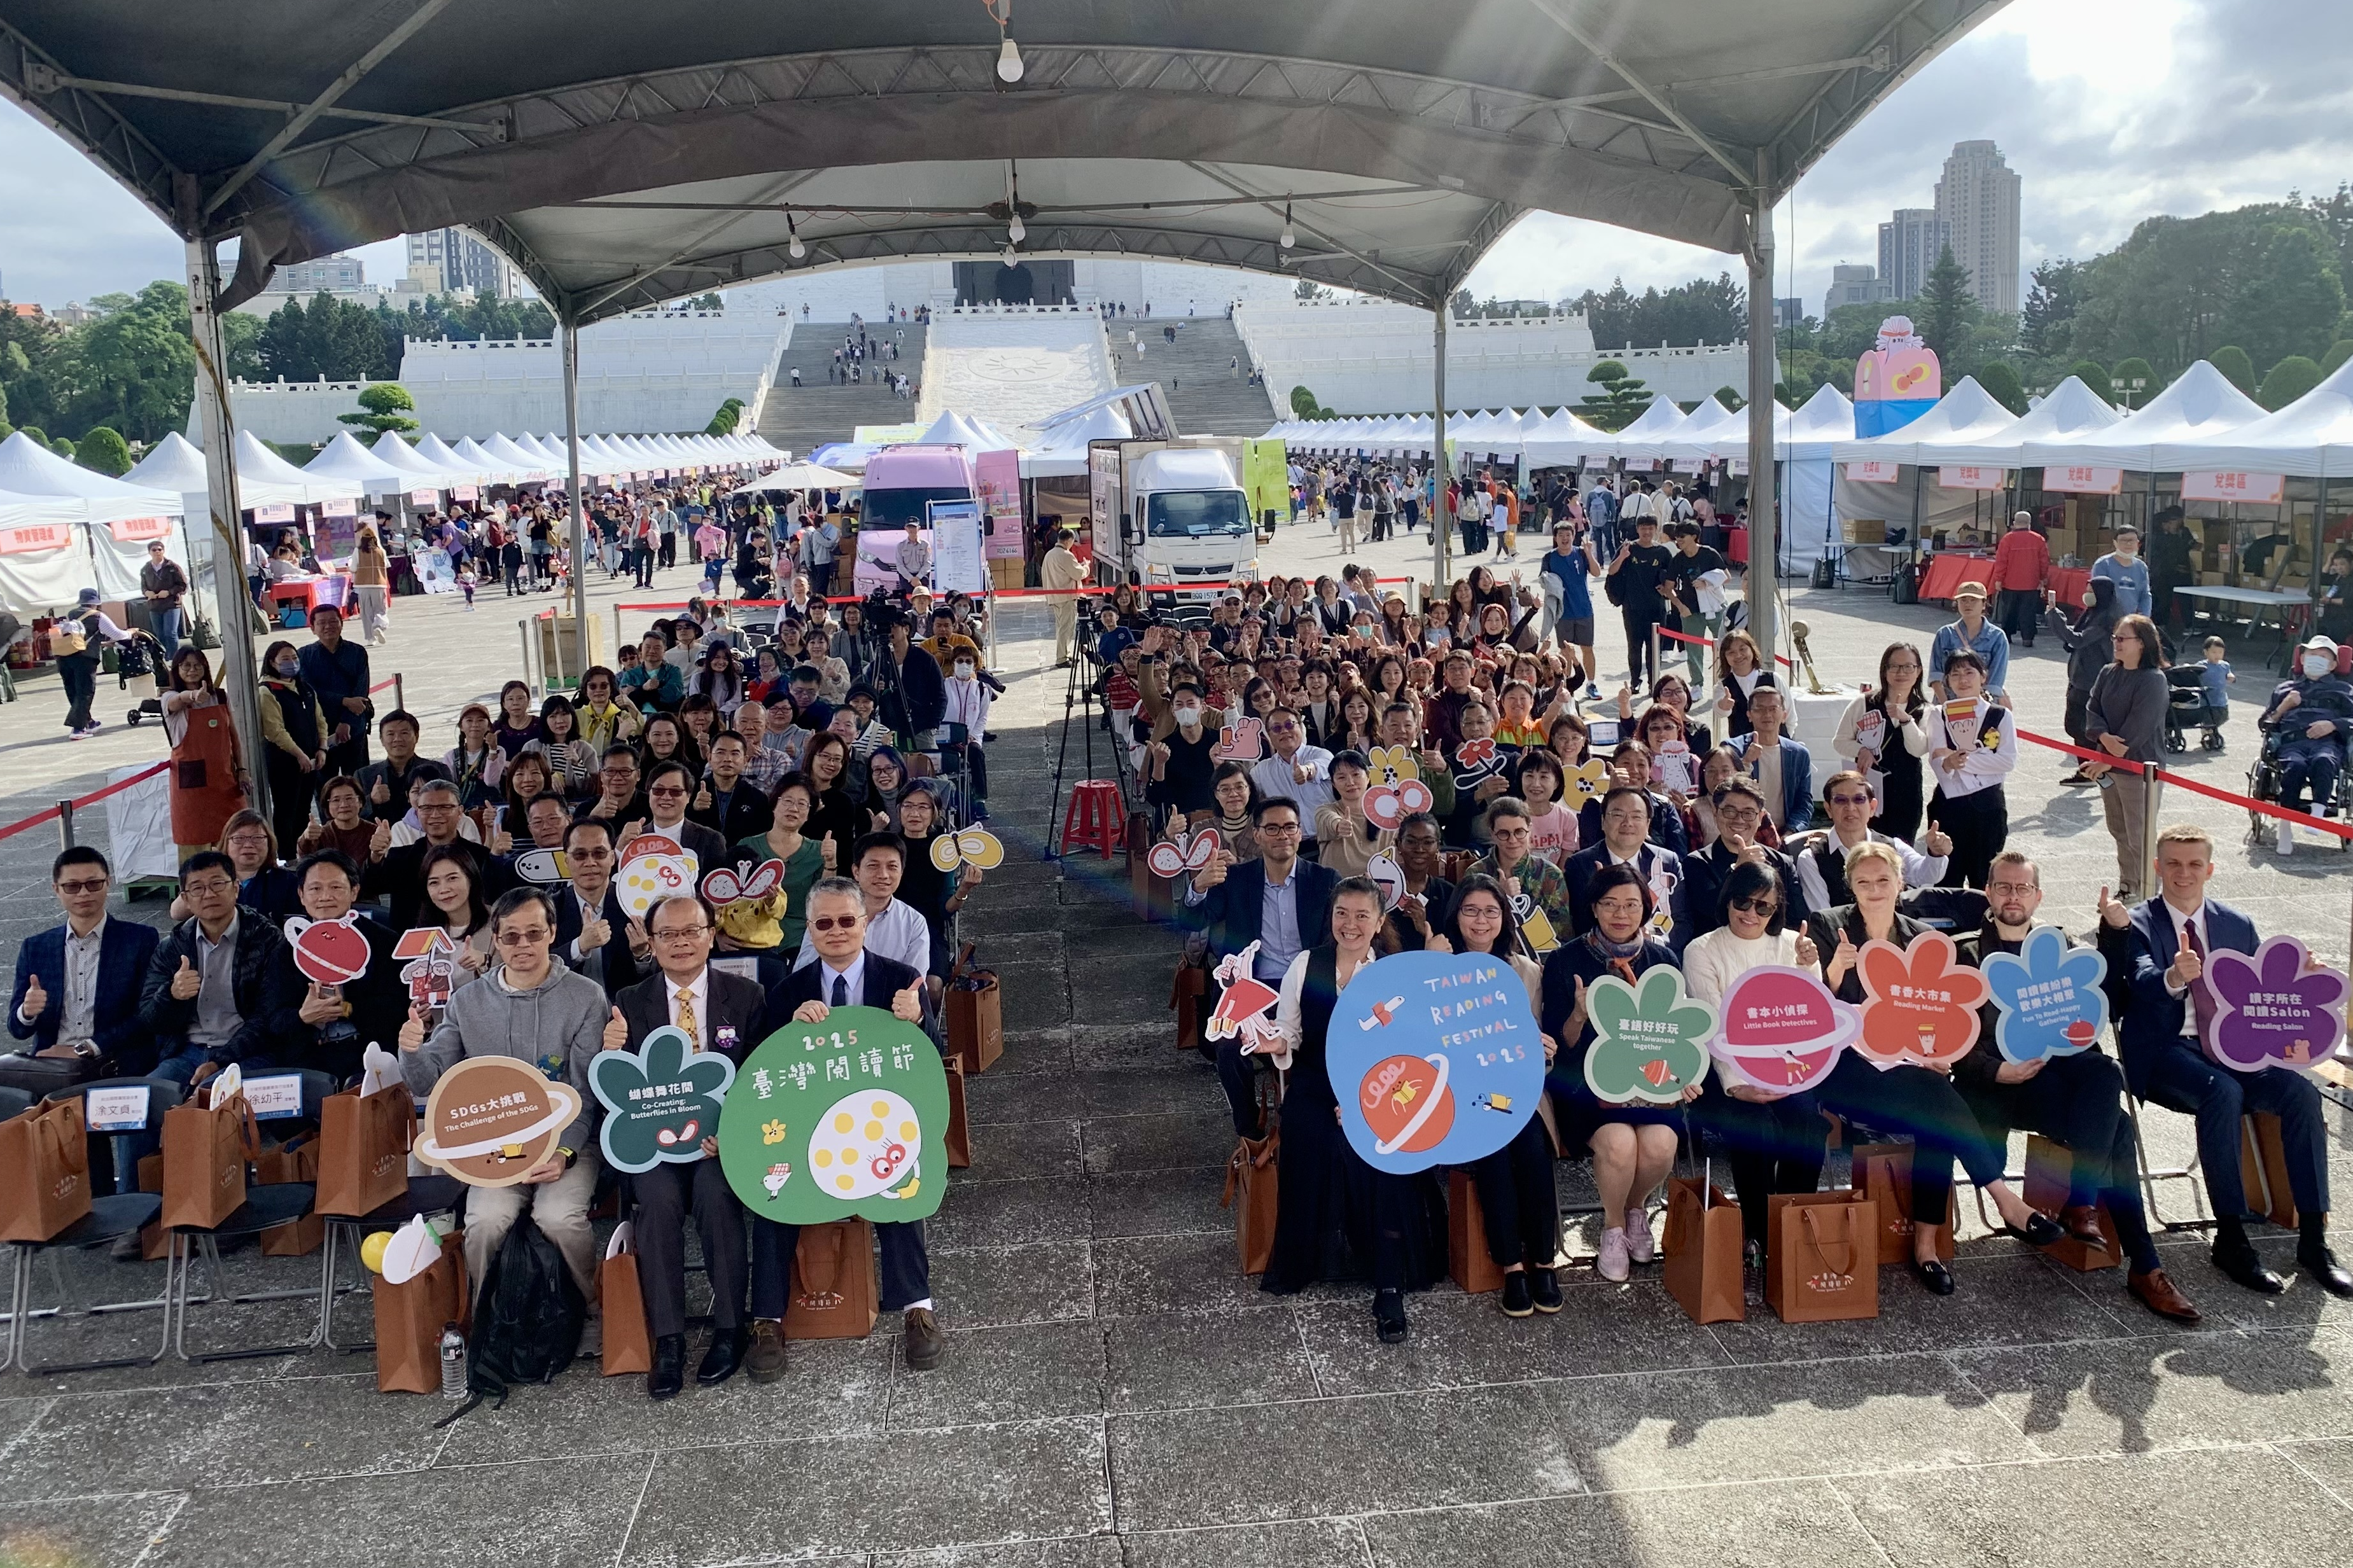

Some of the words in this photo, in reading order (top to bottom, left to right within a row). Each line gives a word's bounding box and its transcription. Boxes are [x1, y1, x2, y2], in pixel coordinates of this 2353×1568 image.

[2214, 473, 2247, 489] 兌獎區
[1423, 968, 1497, 992] TAIWAN
[1889, 983, 1952, 1004] 書香大市集
[1430, 990, 1508, 1025] READING
[1746, 1003, 1809, 1020] 書本小偵探
[1893, 999, 1921, 1012] Reading
[1922, 1003, 1946, 1013] Market
[1743, 1022, 1761, 1030] Little
[1763, 1020, 1780, 1029] Book
[1781, 1018, 1818, 1028] Detectives
[2039, 1015, 2070, 1027] Gathering
[2251, 1022, 2282, 1032] Reading
[2282, 1022, 2305, 1030] Salon
[802, 1029, 858, 1051] 2025
[1441, 1018, 1518, 1048] FESTIVAL
[1618, 1033, 1640, 1043] Speak
[1640, 1034, 1675, 1044] Taiwanese
[1476, 1044, 1526, 1067] 2025
[1633, 1042, 1663, 1051] together
[751, 1043, 915, 1100] 臺灣閱讀節
[629, 1080, 694, 1102] 蝴蝶舞花間
[450, 1091, 527, 1120] SDGs大挑戰
[630, 1107, 668, 1120] Butterflies
[677, 1102, 701, 1113] Bloom
[641, 1099, 687, 1110] Co-Creating:
[444, 1124, 459, 1133] The
[459, 1118, 496, 1131] Challenge
[505, 1109, 519, 1118] the
[519, 1104, 538, 1115] SDGs
